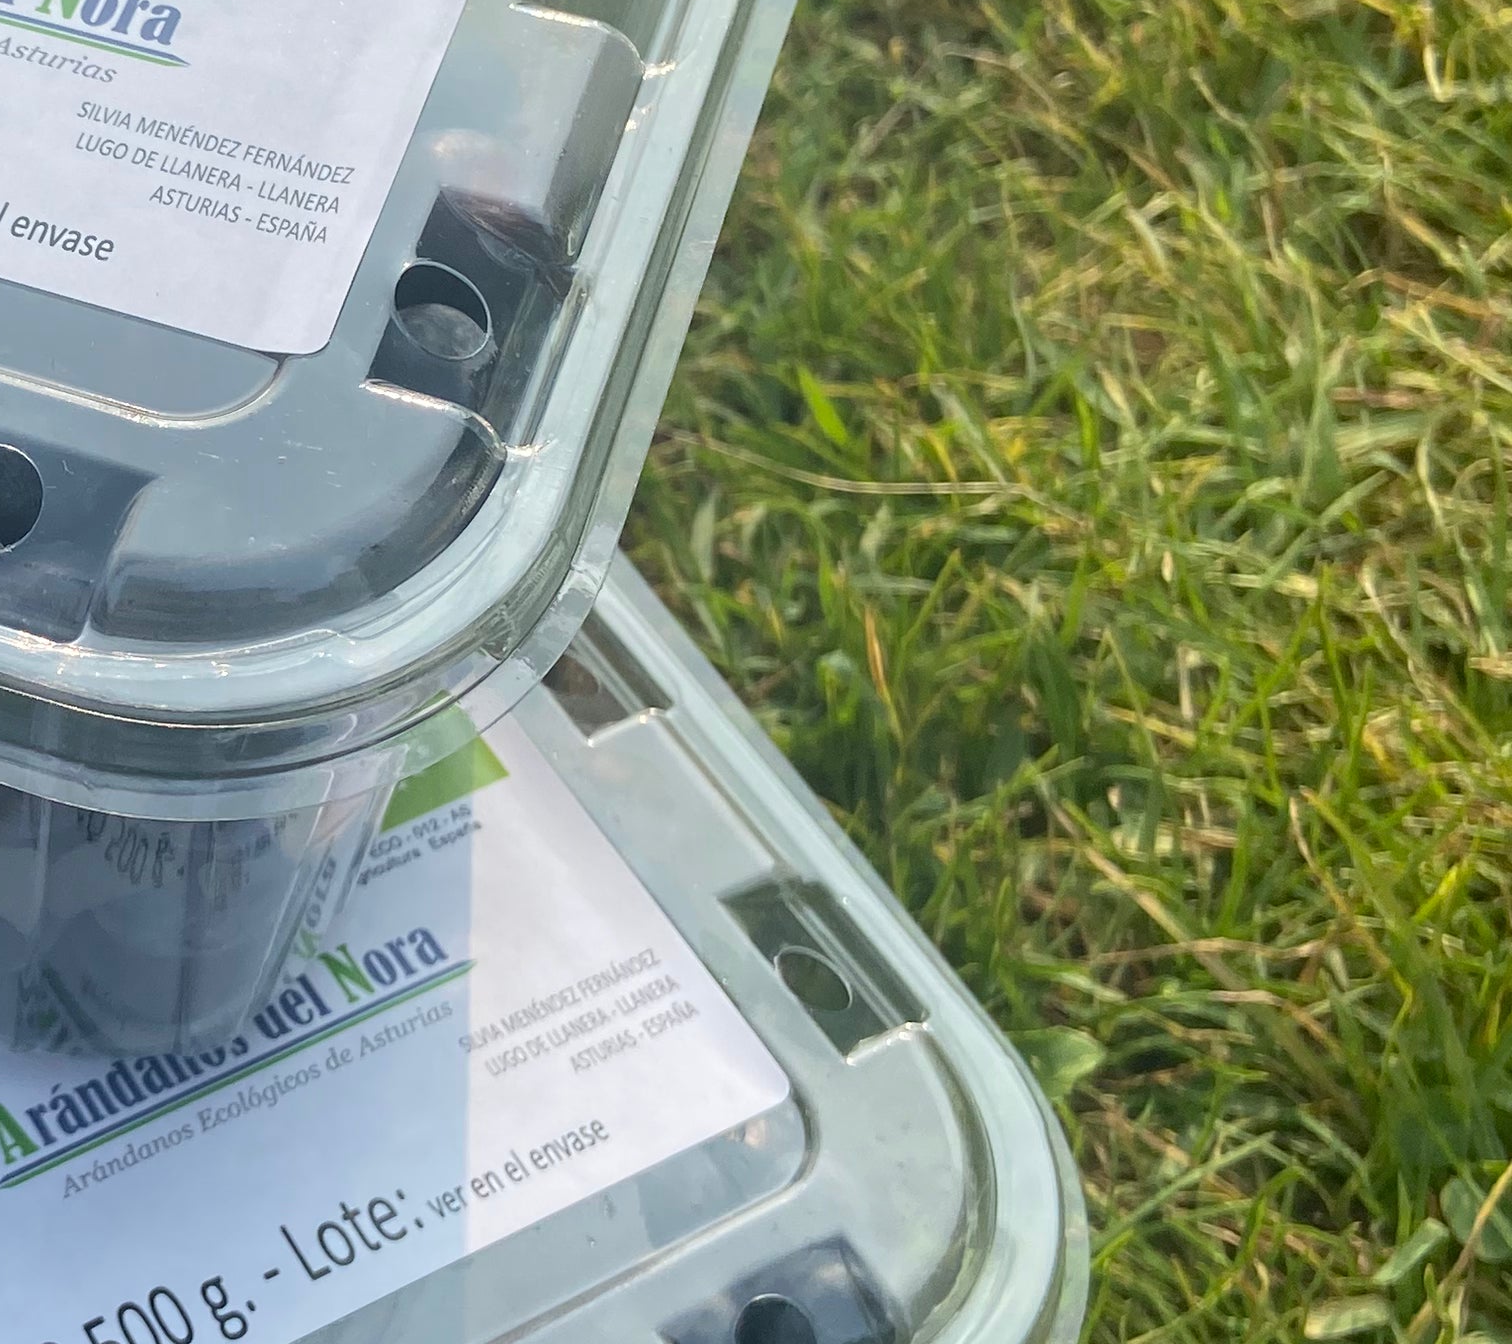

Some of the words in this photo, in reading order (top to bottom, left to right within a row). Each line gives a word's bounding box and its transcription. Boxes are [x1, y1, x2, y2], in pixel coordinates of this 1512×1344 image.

[75, 132, 129, 160] LUGO
[131, 147, 159, 169] DE
[160, 155, 242, 192] LLANERA
[257, 180, 340, 214] LLANERA
[77, 101, 131, 130] SILVIA
[136, 116, 242, 158] MENÉNDEZ
[243, 144, 355, 185] FERNÁNDEZ
[10, 213, 115, 263] envase
[149, 185, 242, 223] ASTURIAS
[255, 212, 328, 244] ESPAÑA
[318, 926, 450, 1004] Nora
[62, 1119, 195, 1199] Arándanos
[196, 1062, 322, 1134] Ecológicos
[325, 1046, 354, 1071] de
[359, 1001, 454, 1059] Asturias
[200, 1275, 257, 1340] g.
[279, 1188, 424, 1281] Lote:
[427, 1185, 469, 1218] ver
[471, 1167, 505, 1199] en
[504, 1149, 530, 1183] el
[529, 1118, 610, 1171] envase
